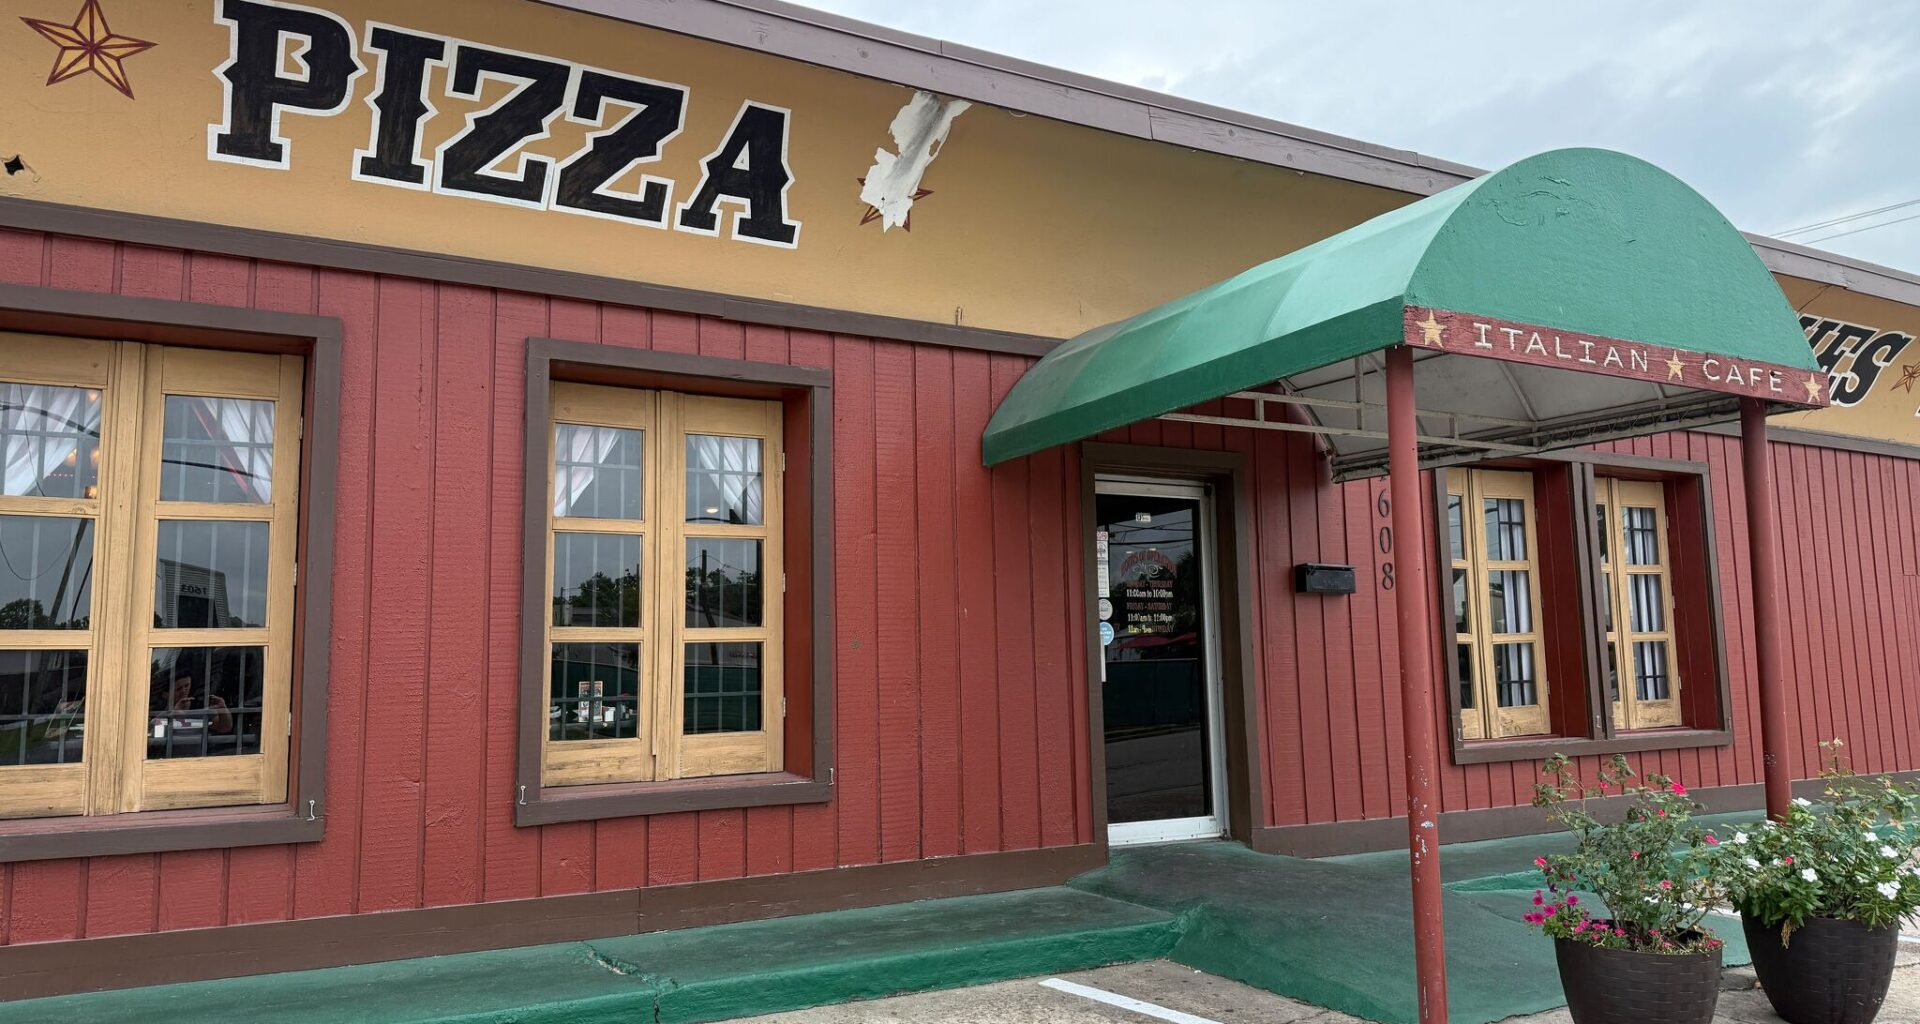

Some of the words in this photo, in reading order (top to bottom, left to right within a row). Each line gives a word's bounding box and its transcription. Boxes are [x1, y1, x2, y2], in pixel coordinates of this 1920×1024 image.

[207, 0, 802, 249] PIZZA
[1473, 321, 1649, 372] ITALIAN
[1703, 358, 1784, 393] CAFE
[1377, 476, 1395, 591] 608
